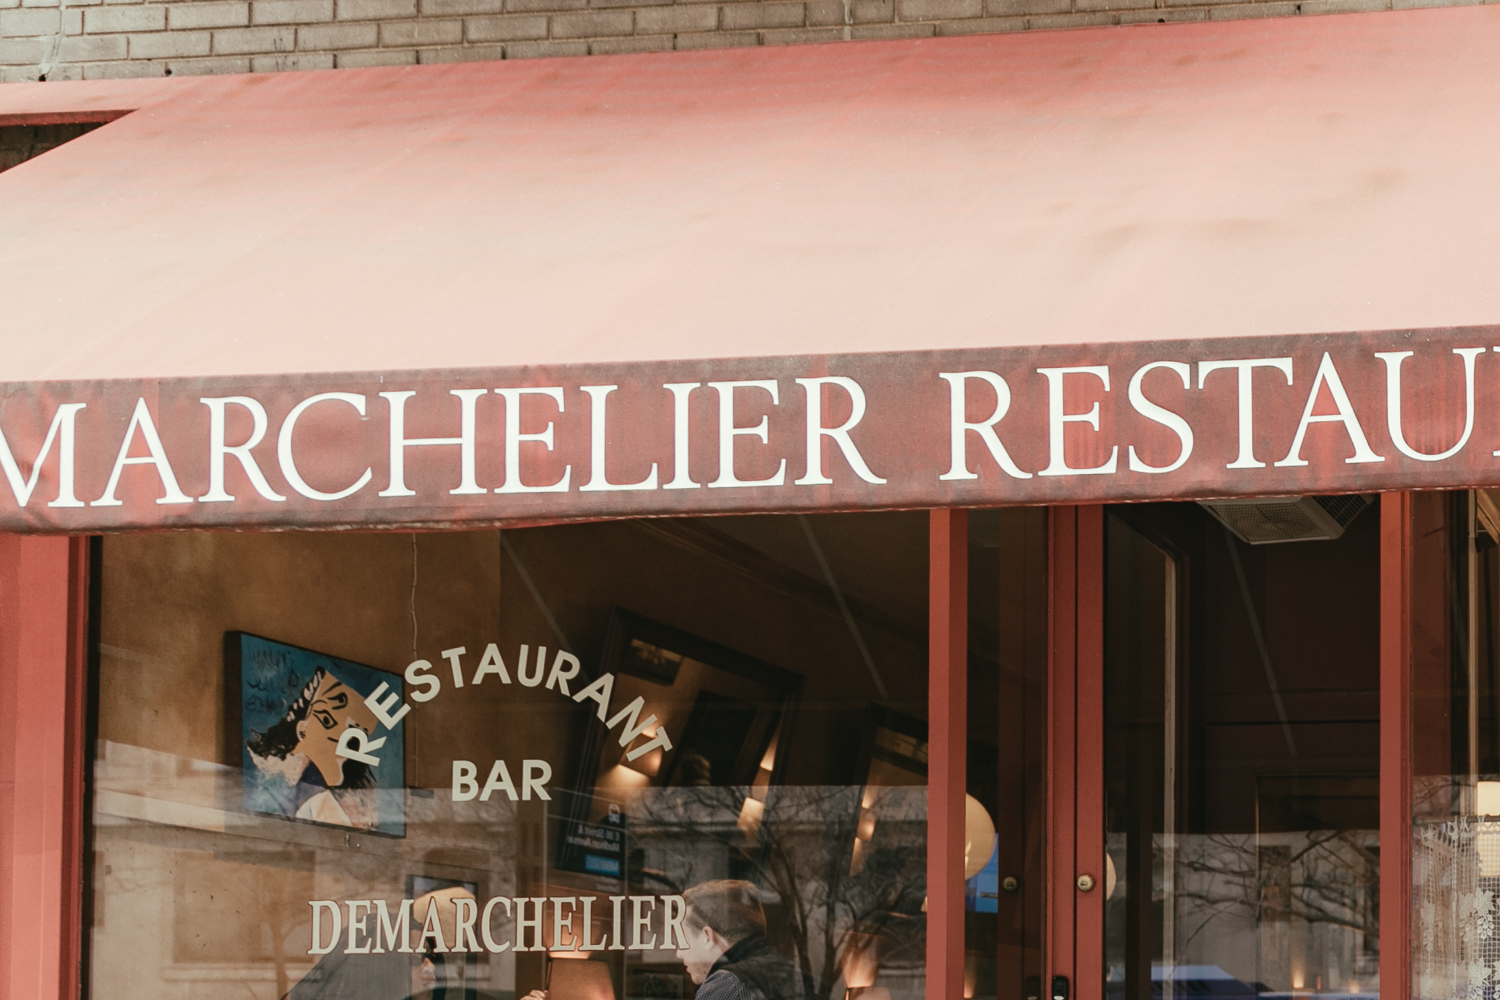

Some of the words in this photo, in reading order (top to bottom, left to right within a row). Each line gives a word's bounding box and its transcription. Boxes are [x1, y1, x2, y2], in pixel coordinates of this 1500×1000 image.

[0, 376, 888, 509] MARCHELIER
[334, 642, 674, 768] RESTAURANT
[451, 759, 552, 801] BAR
[307, 894, 691, 955] DEMARCHELIER
